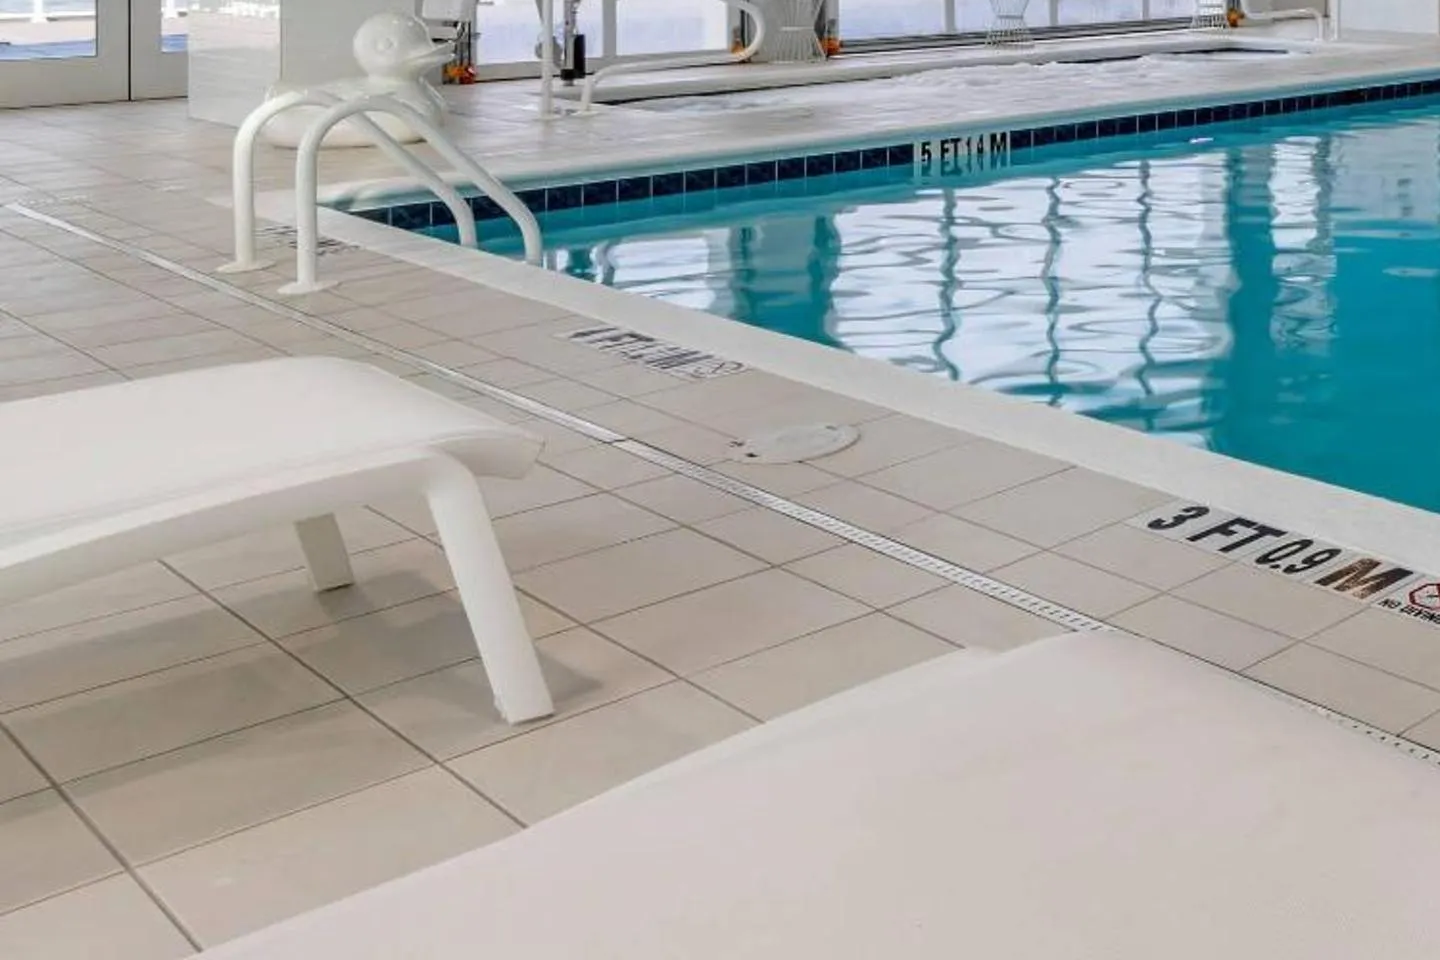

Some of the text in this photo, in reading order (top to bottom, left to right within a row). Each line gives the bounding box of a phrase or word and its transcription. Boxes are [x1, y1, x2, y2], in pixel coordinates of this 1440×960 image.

[921, 141, 932, 161] 5
[940, 137, 961, 160] FT
[990, 131, 1007, 153] M
[1147, 506, 1414, 600] 3 FT 0.9 M
[1378, 598, 1402, 609] NO
